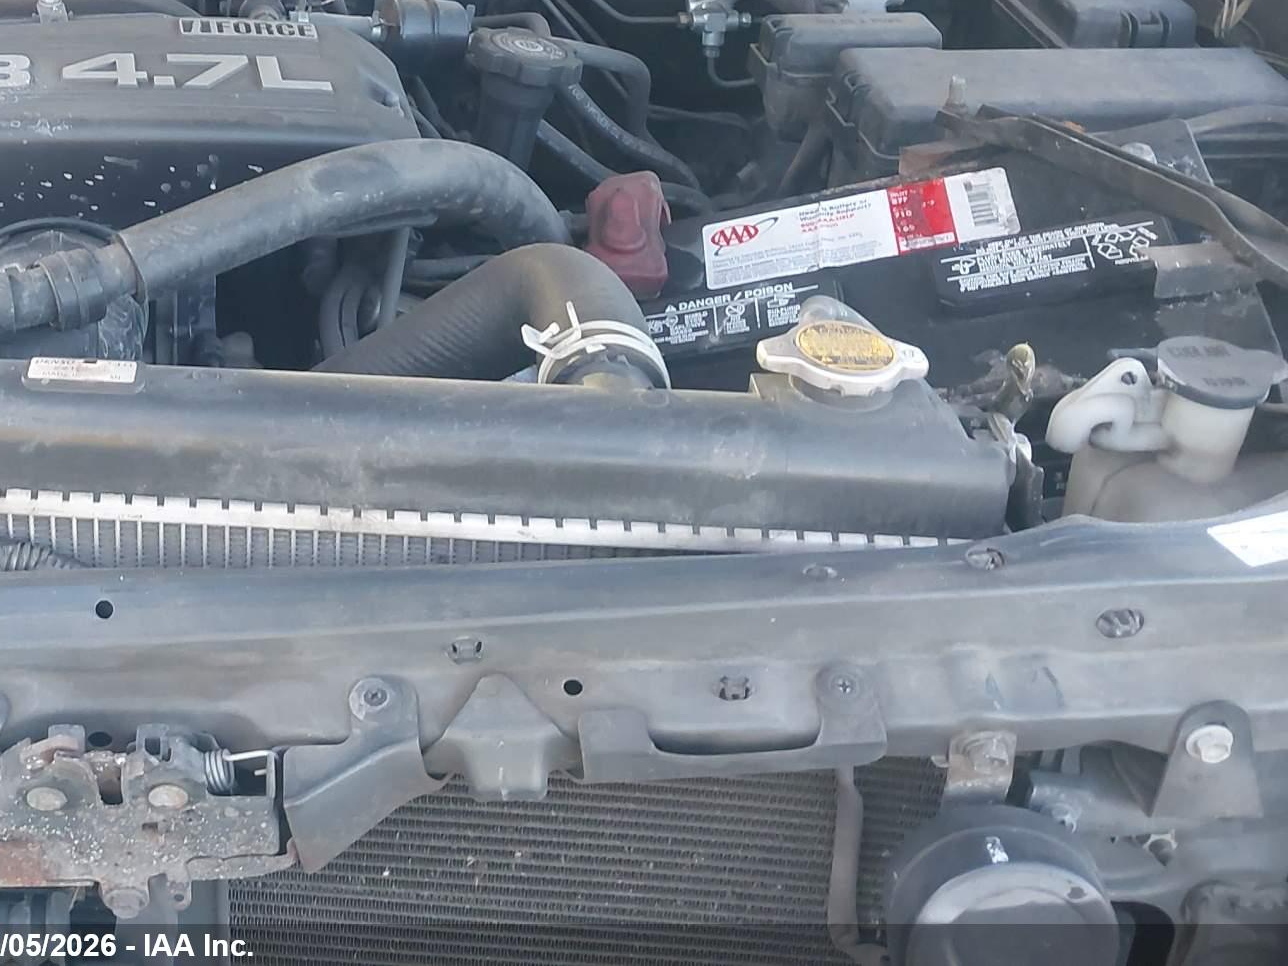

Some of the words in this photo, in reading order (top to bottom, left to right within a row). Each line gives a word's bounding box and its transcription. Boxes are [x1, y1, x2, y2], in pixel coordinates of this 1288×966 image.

[62, 53, 334, 92] 4.7L
[713, 224, 759, 247] AAA
[678, 293, 732, 311] DANGER
[744, 282, 793, 300] POISON
